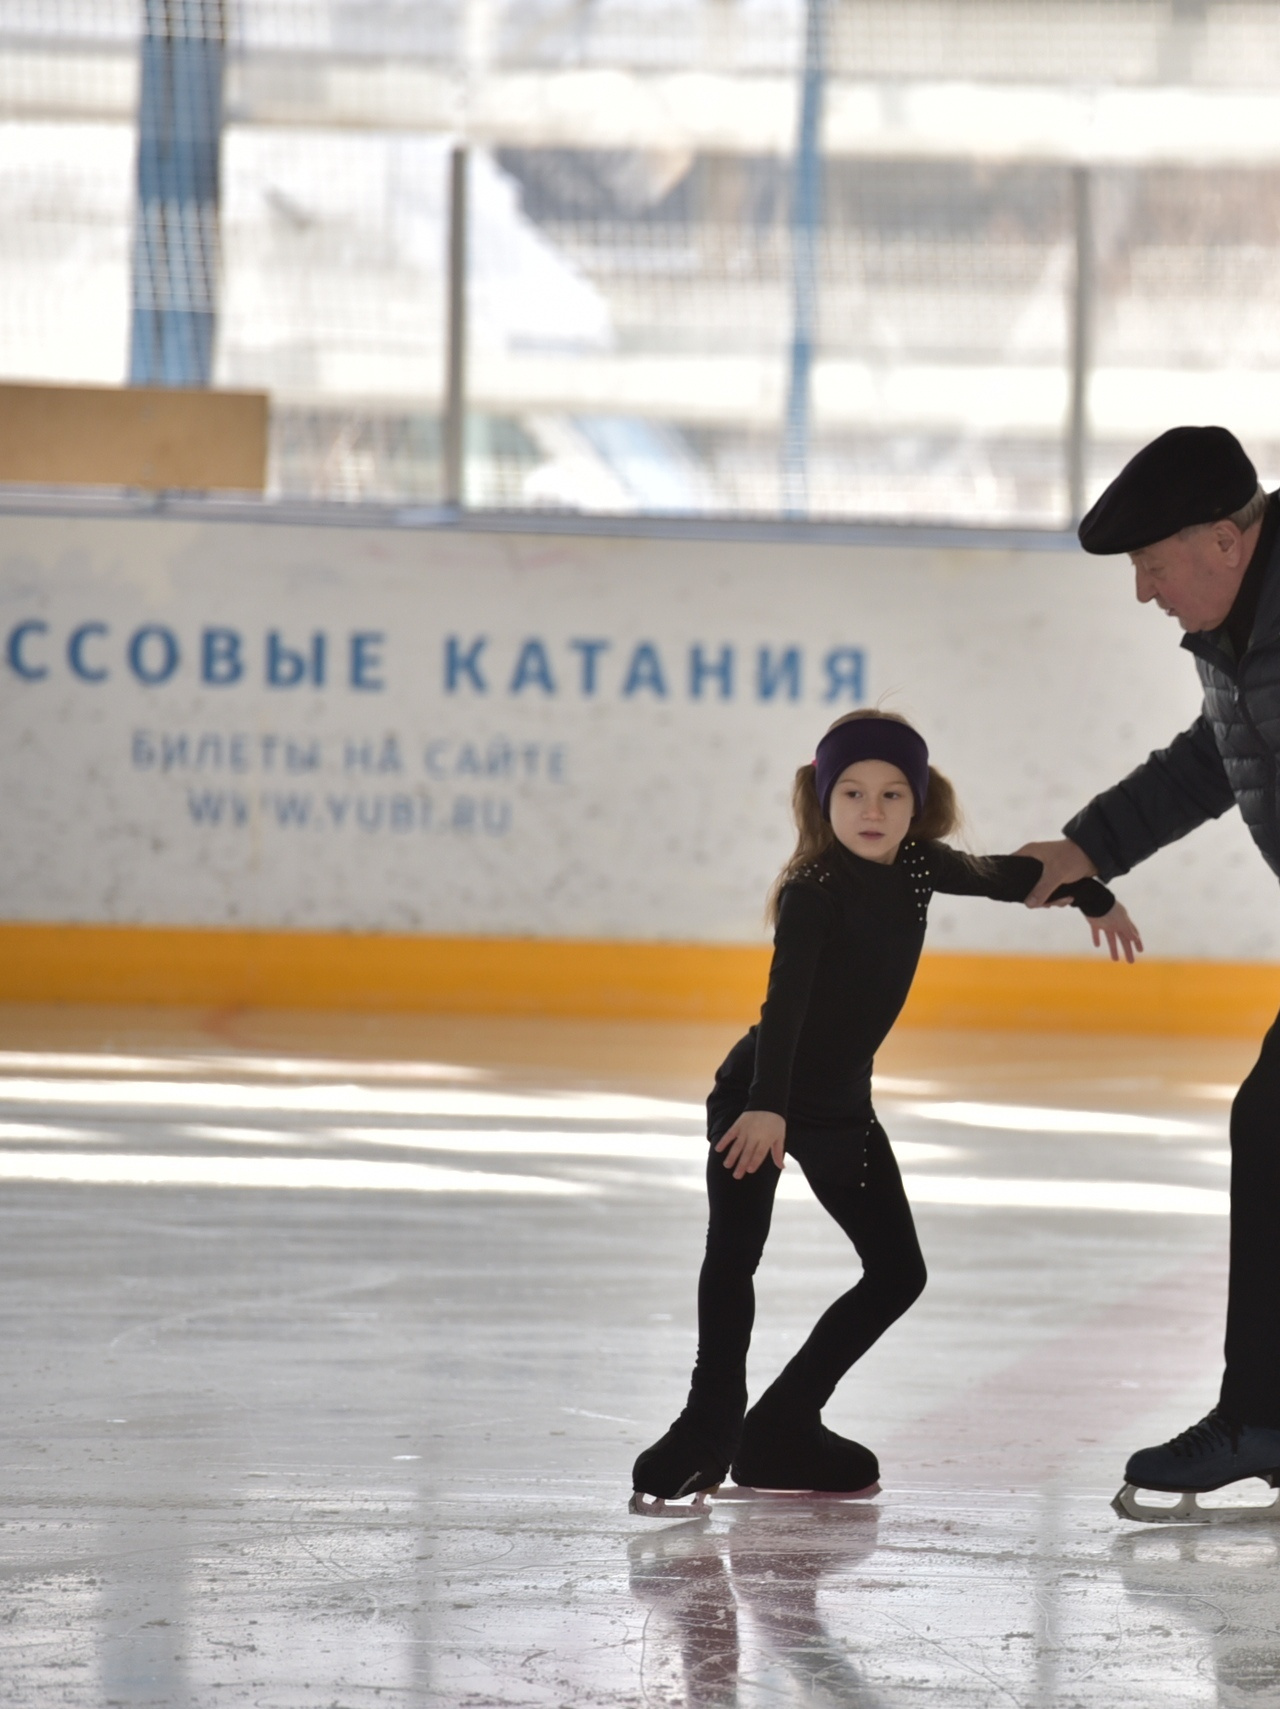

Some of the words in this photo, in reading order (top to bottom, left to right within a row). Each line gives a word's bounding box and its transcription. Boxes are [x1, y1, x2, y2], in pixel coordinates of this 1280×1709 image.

[6, 617, 388, 692] ССОВЫЕ
[441, 632, 868, 705] КАТАНИЯ
[131, 729, 322, 775] БИЛЕТЫ
[342, 737, 406, 774] НА
[423, 734, 567, 785] САЙТЕ
